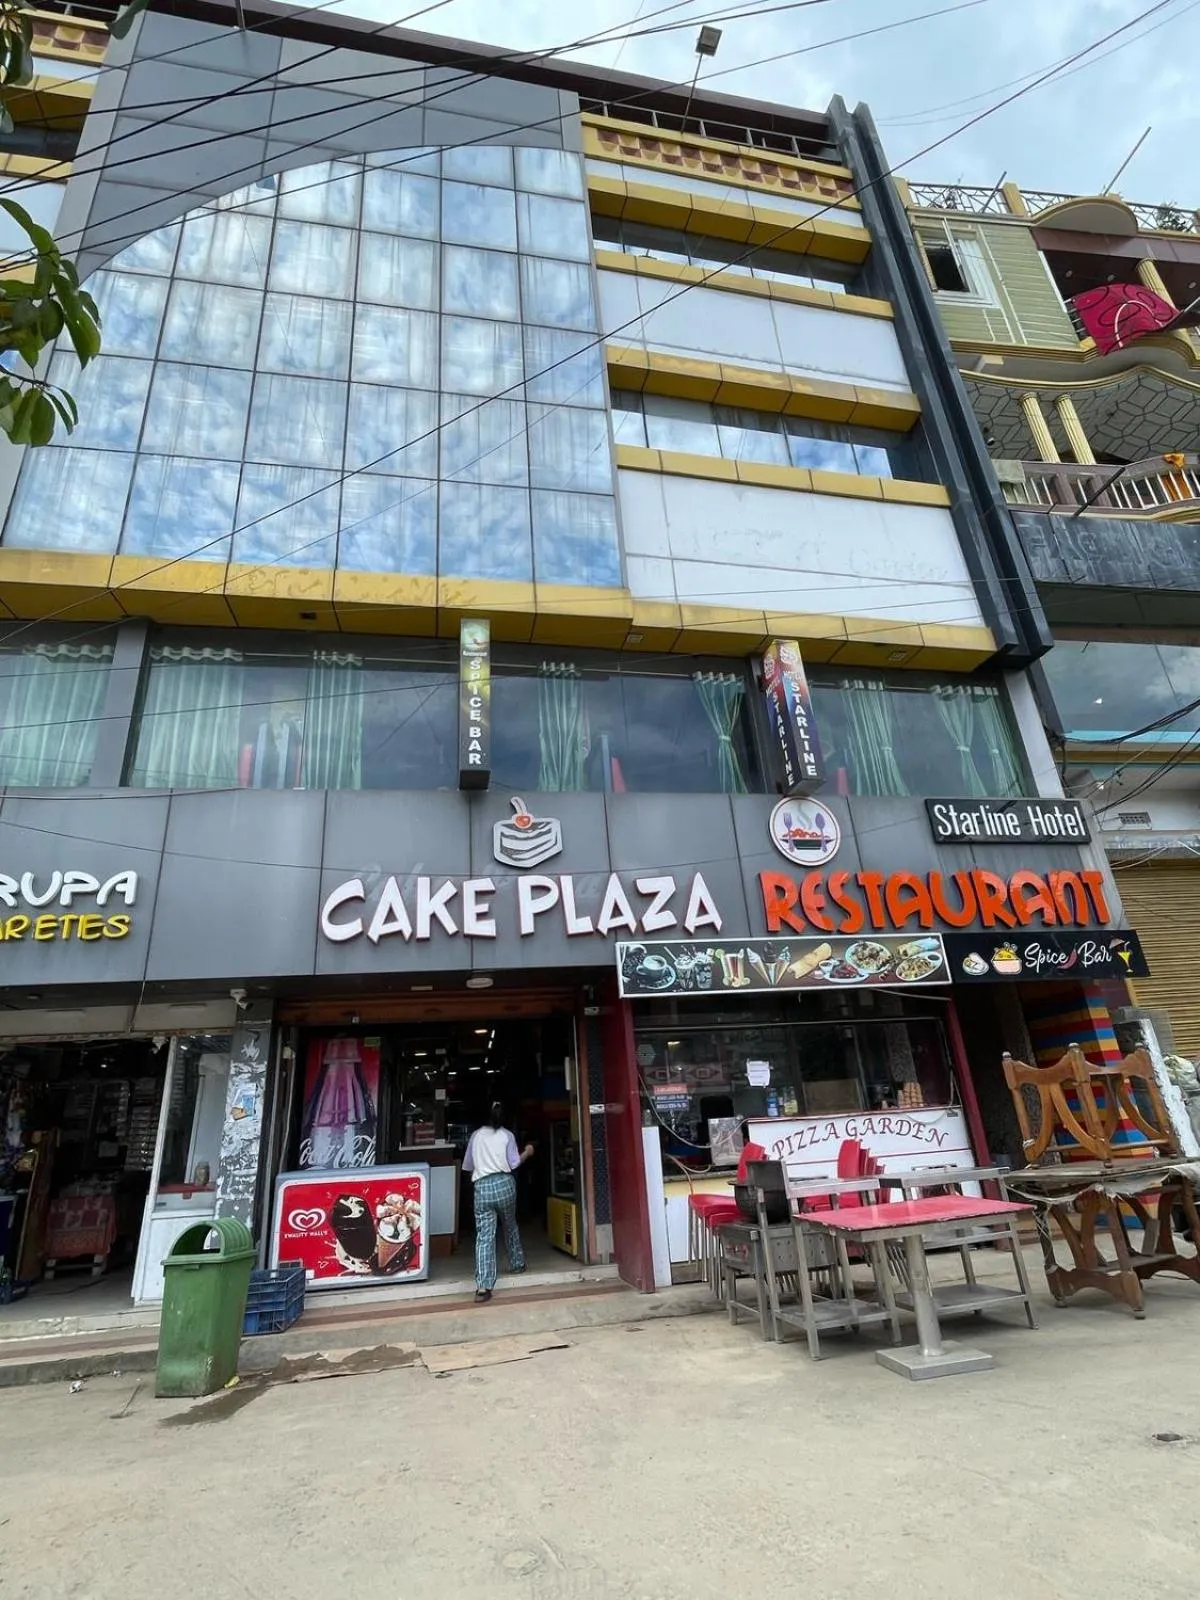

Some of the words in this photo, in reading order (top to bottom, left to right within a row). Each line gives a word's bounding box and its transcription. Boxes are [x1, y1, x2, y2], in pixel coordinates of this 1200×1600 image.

[468, 659, 483, 721] SPICE
[468, 726, 482, 765] BAR
[772, 691, 795, 786] STARLINE
[791, 682, 817, 776] STARLINE
[934, 804, 1021, 836] Starline
[1027, 806, 1086, 836] Hotel
[321, 876, 496, 944] CAKE
[517, 872, 723, 936] PLAZA
[758, 869, 1111, 934] RESTAURANT
[1024, 942, 1068, 973] Spice
[1078, 940, 1112, 968] Bar
[772, 1121, 840, 1160] PIZZA
[845, 1117, 949, 1147] GARDEN
